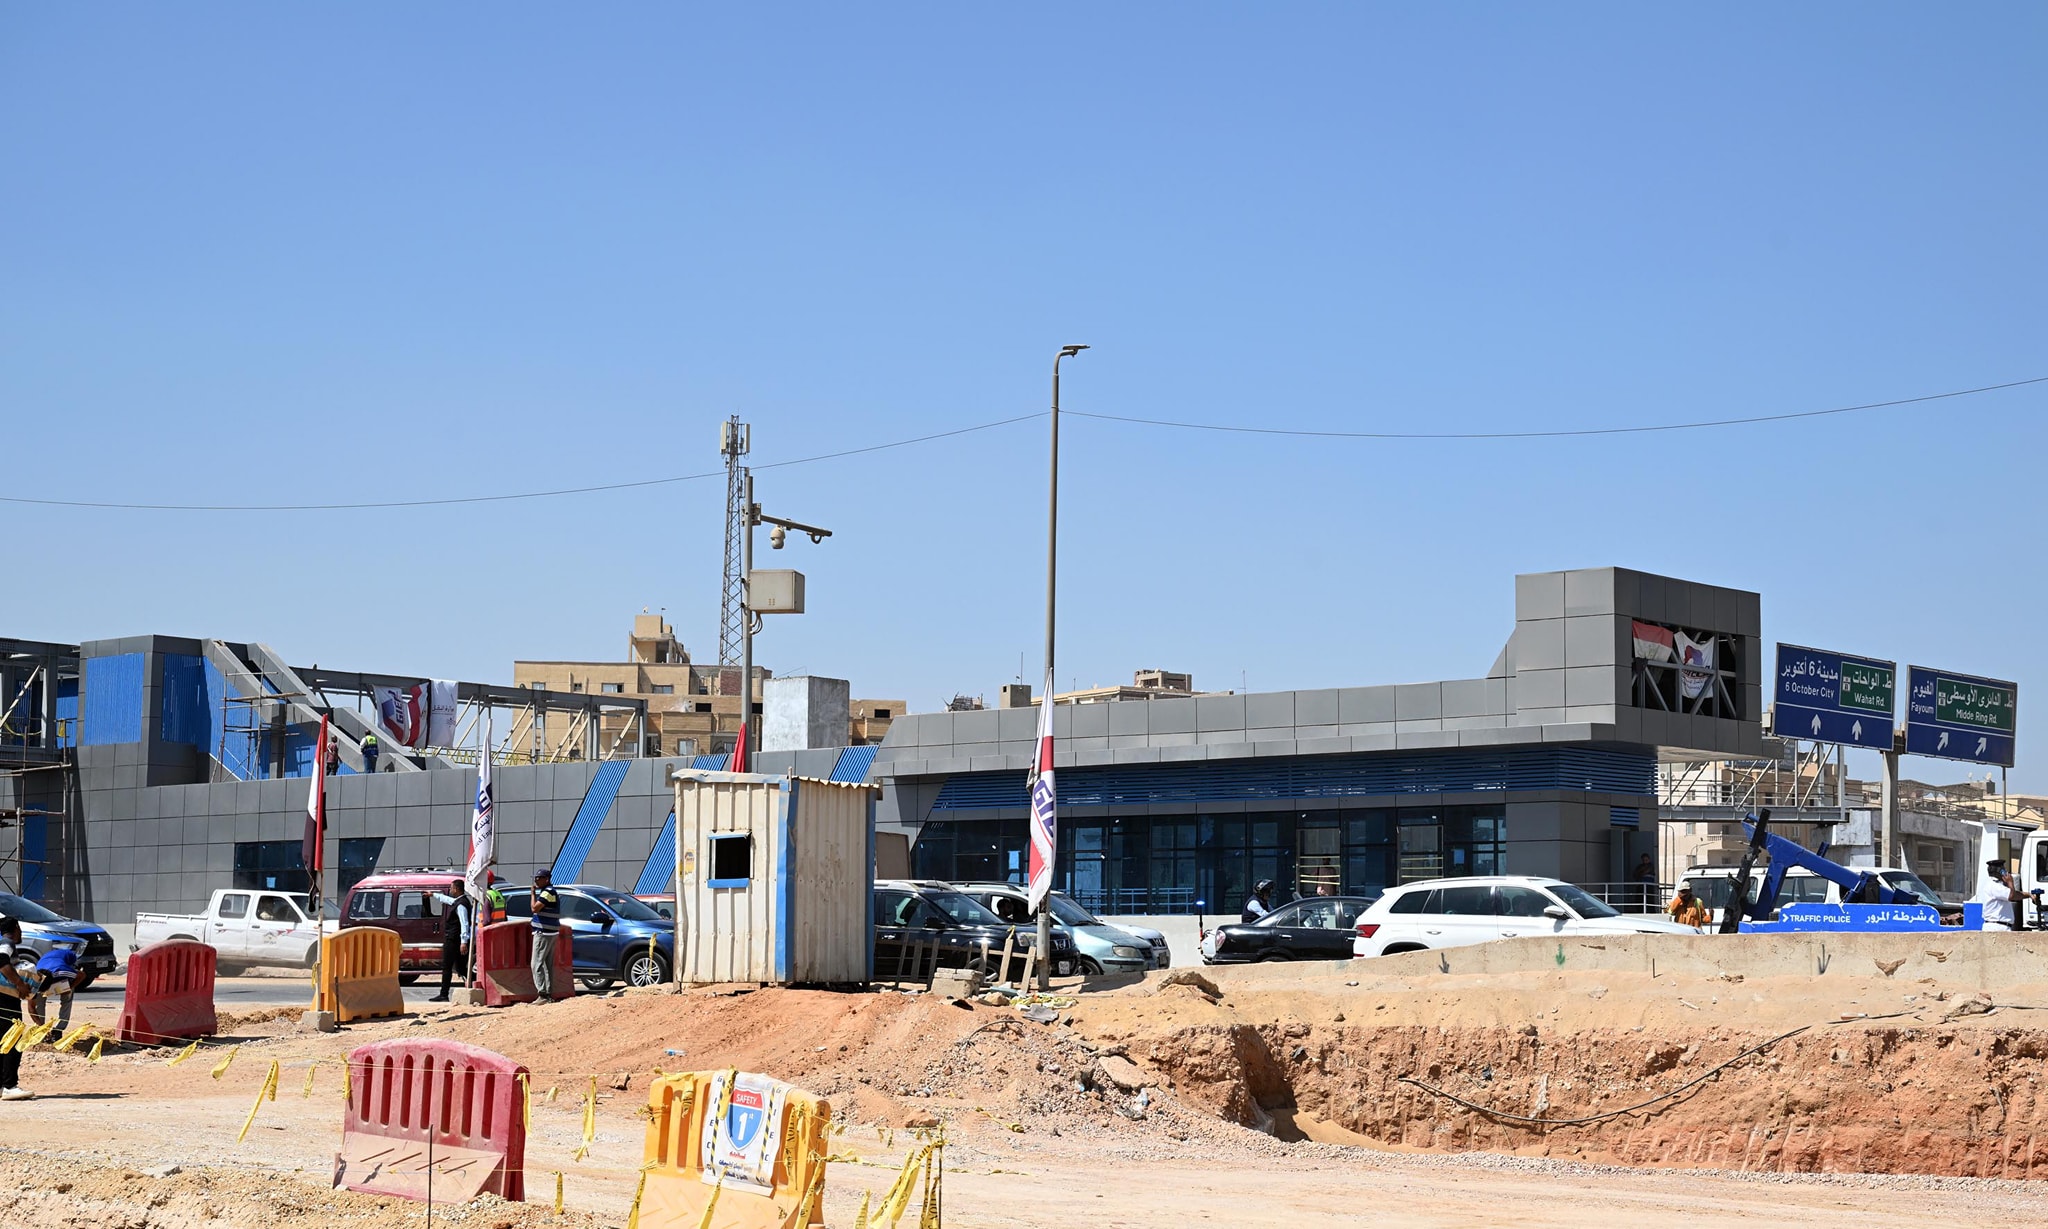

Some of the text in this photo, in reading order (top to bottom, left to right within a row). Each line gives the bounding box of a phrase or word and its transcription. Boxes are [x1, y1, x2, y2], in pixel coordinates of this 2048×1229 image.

[1780, 656, 1839, 682] مدينة 6 أكتوبر
[1852, 670, 1880, 690] الواحات
[1785, 681, 1835, 699] 6 October City
[1913, 680, 1934, 699] الفيوم
[1854, 692, 1875, 705] Wahat
[1911, 701, 1934, 715] Fayoum
[1956, 708, 1974, 721] Midde
[1975, 711, 1988, 725] Ring
[1790, 914, 1851, 923] TRAFFIC POLICE
[1865, 909, 1927, 924] شرطة المرور
[736, 1093, 758, 1105] SAFETY
